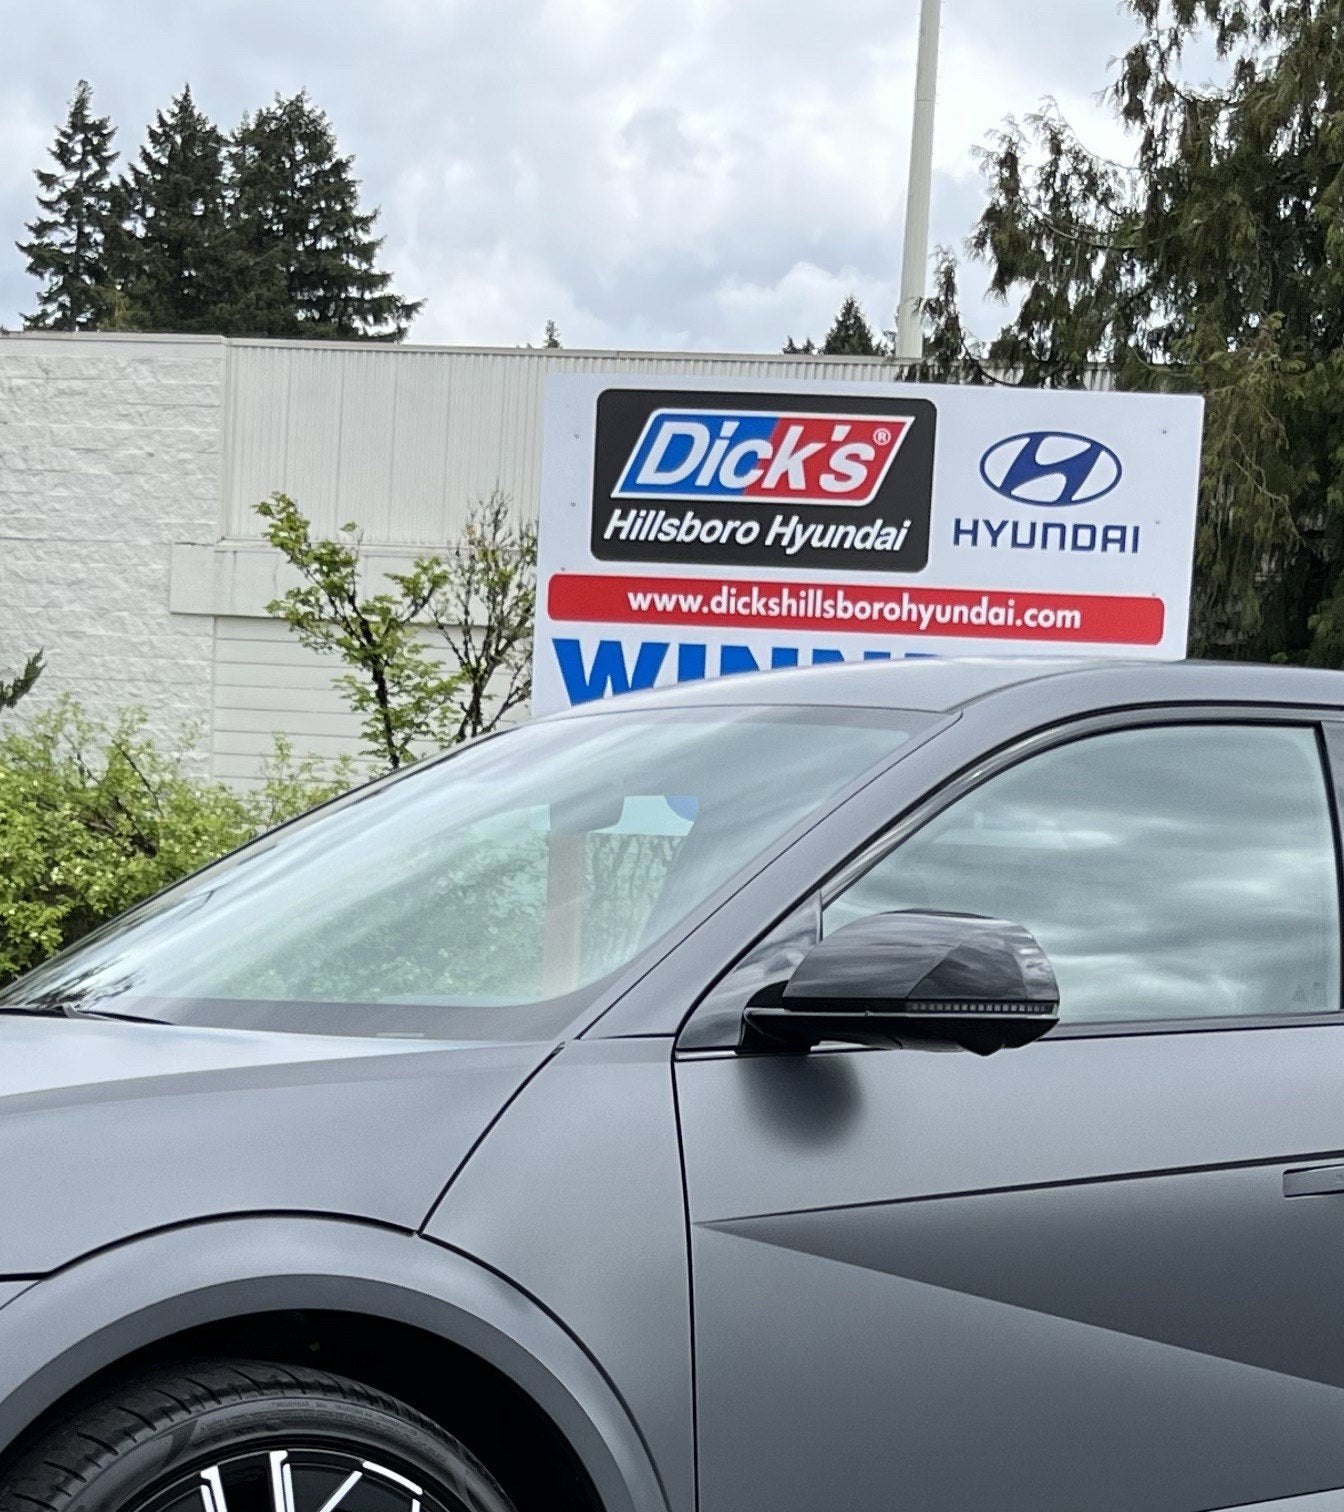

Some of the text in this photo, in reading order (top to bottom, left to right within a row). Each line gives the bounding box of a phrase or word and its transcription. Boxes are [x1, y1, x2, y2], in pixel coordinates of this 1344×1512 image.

[603, 509, 912, 555] Hillsboro Hyundai
[954, 518, 1140, 554] HYUNDAI
[628, 586, 1081, 630] www.dickshillsborohyundai.com
